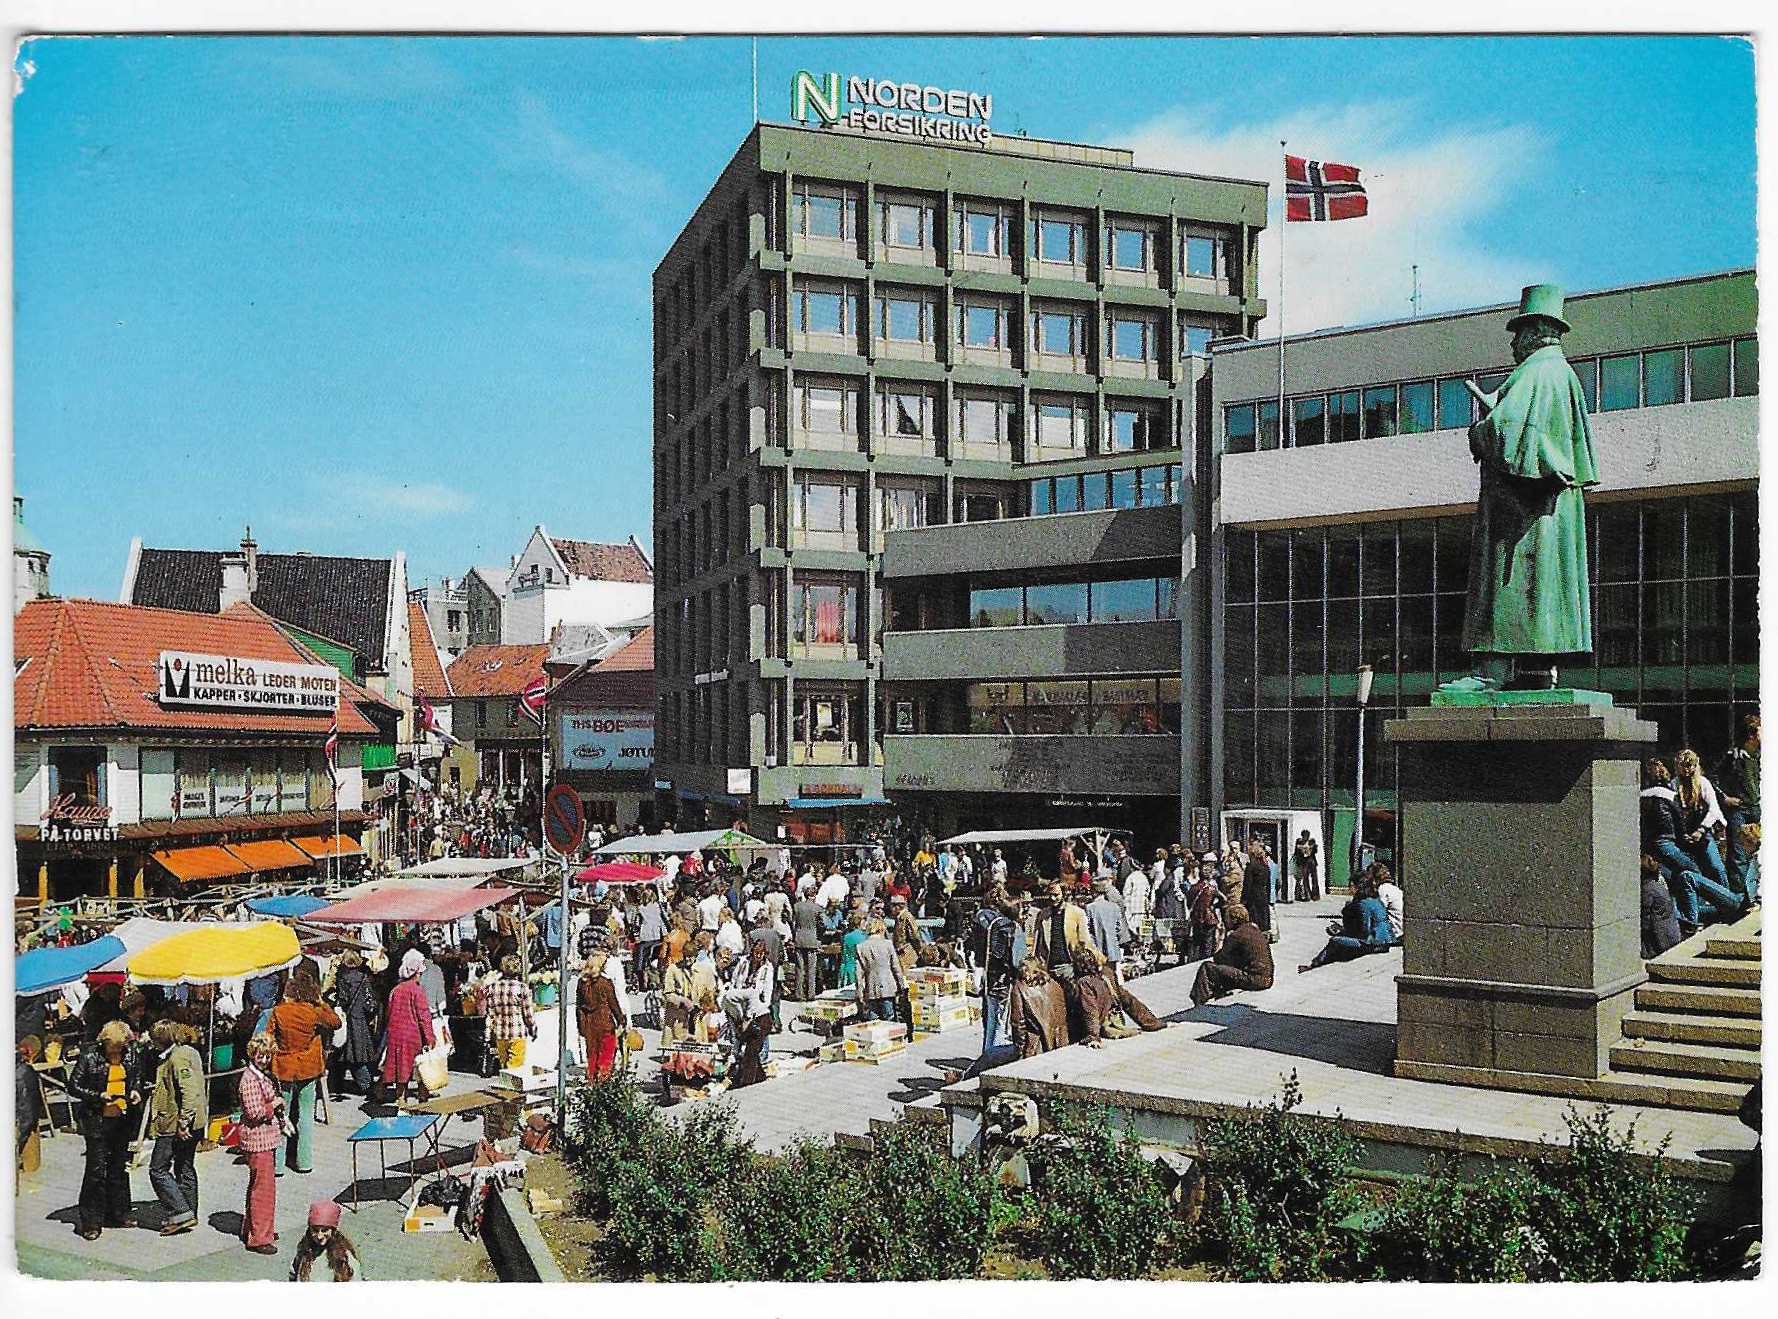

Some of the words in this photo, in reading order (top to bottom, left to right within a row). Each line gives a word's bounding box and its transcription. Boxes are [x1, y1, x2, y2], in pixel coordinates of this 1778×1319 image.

[791, 70, 842, 124] N
[847, 75, 993, 120] NORDEN
[849, 108, 993, 143] FORSIKRING
[195, 658, 257, 686] melka
[263, 672, 297, 690] LEDER
[193, 687, 236, 702] KAPPER
[243, 690, 295, 705] SKJORTER
[300, 693, 337, 708] BLUSER
[41, 825, 59, 842] PÅ
[63, 828, 120, 842] TORVET
